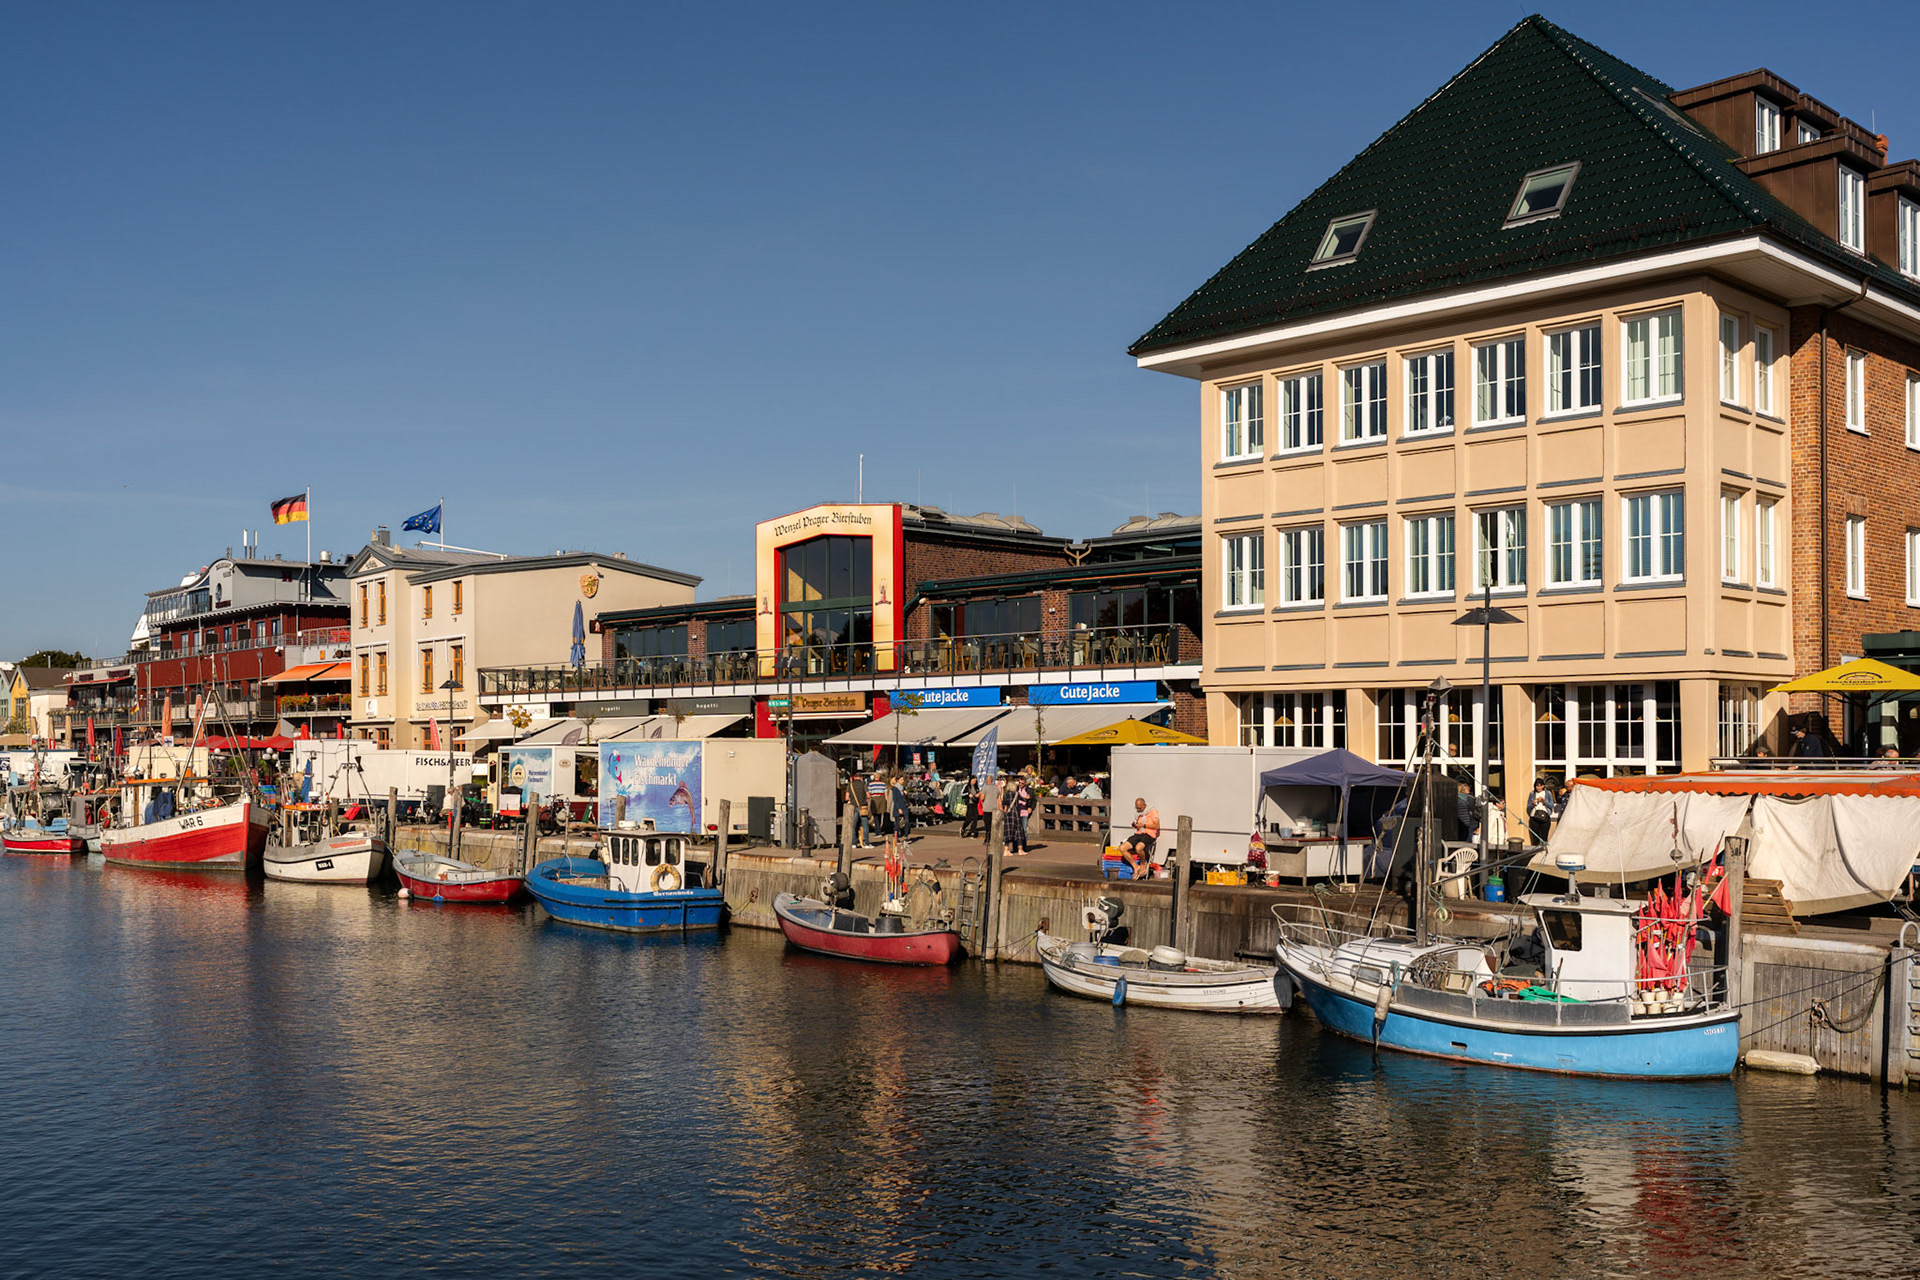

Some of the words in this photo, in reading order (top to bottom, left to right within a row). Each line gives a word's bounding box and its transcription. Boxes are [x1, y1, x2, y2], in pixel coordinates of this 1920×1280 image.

[774, 519, 802, 536] Wenzel
[803, 516, 829, 528] Prager
[918, 689, 969, 705] GuteJacke
[1060, 684, 1120, 701] GuteJacke
[178, 817, 196, 830] WAR
[196, 816, 203, 826] 6
